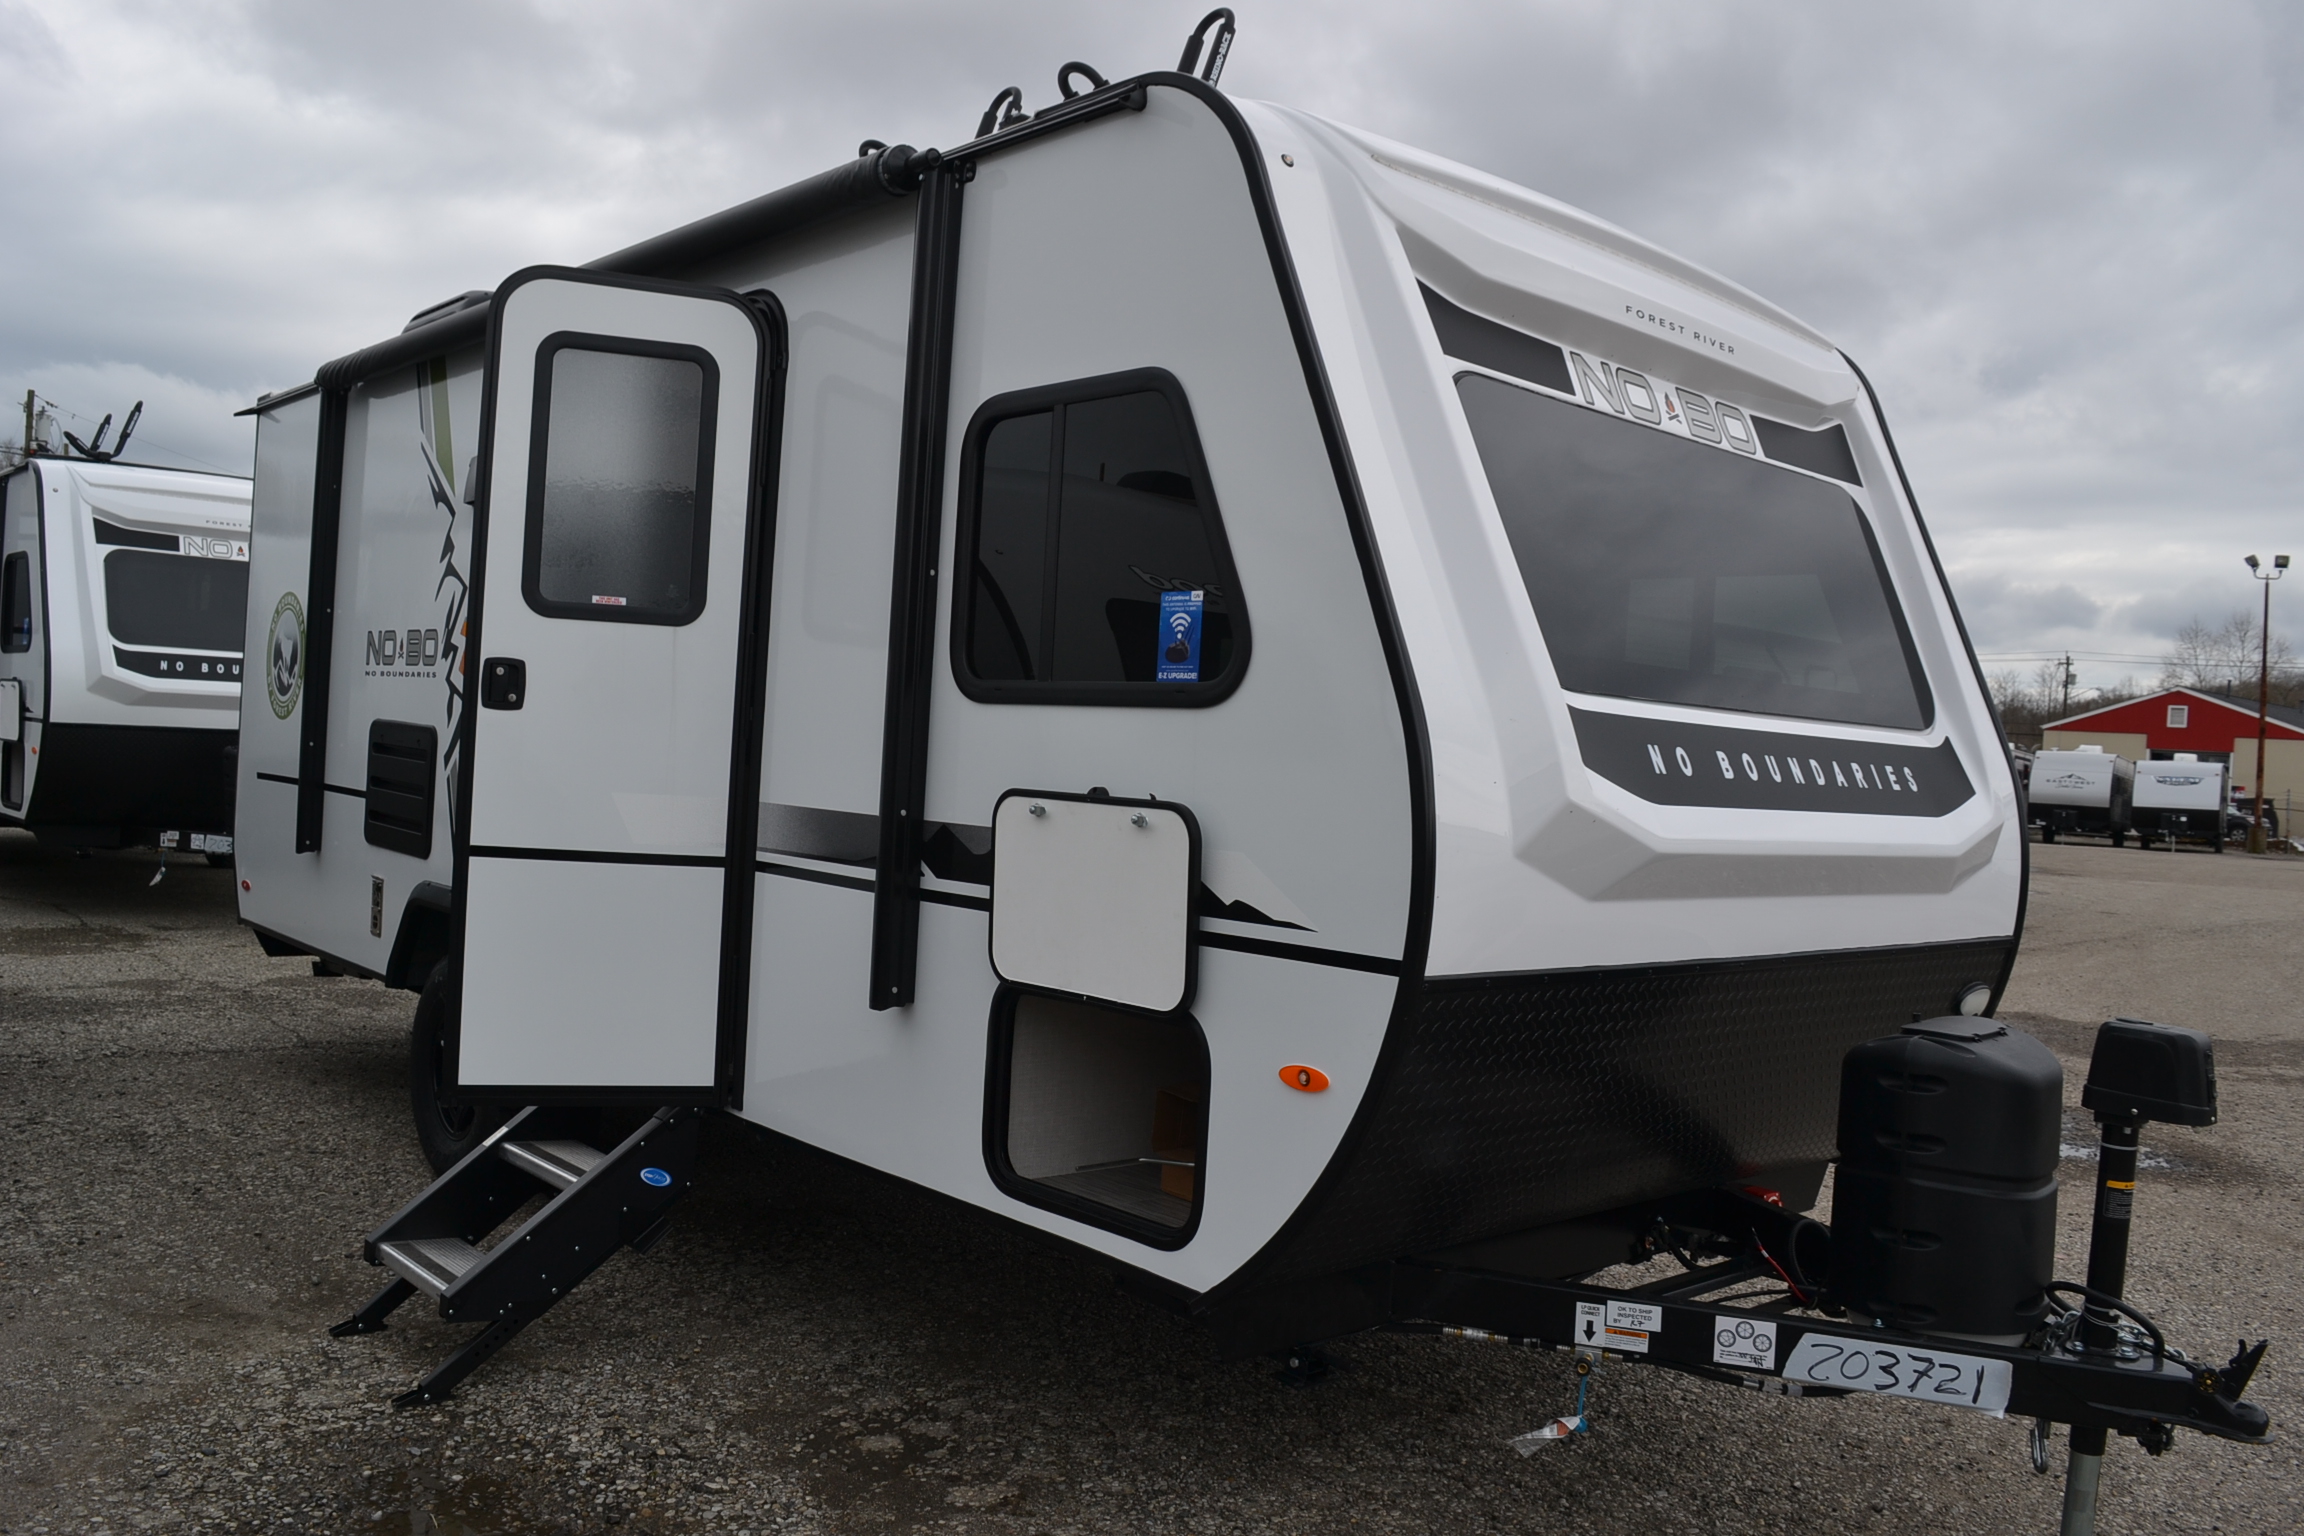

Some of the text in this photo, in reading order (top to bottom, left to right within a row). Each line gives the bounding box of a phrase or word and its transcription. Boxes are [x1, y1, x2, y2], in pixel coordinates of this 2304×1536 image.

[1625, 305, 1735, 355] FOREST RIVER
[183, 536, 233, 558] NO
[160, 660, 184, 671] NO
[380, 670, 437, 678] BOUNDARIES
[1647, 744, 1919, 792] NO BOUNDARIES
[1617, 1313, 1653, 1321] INSPECTED
[1808, 1343, 1986, 1405] 203721
